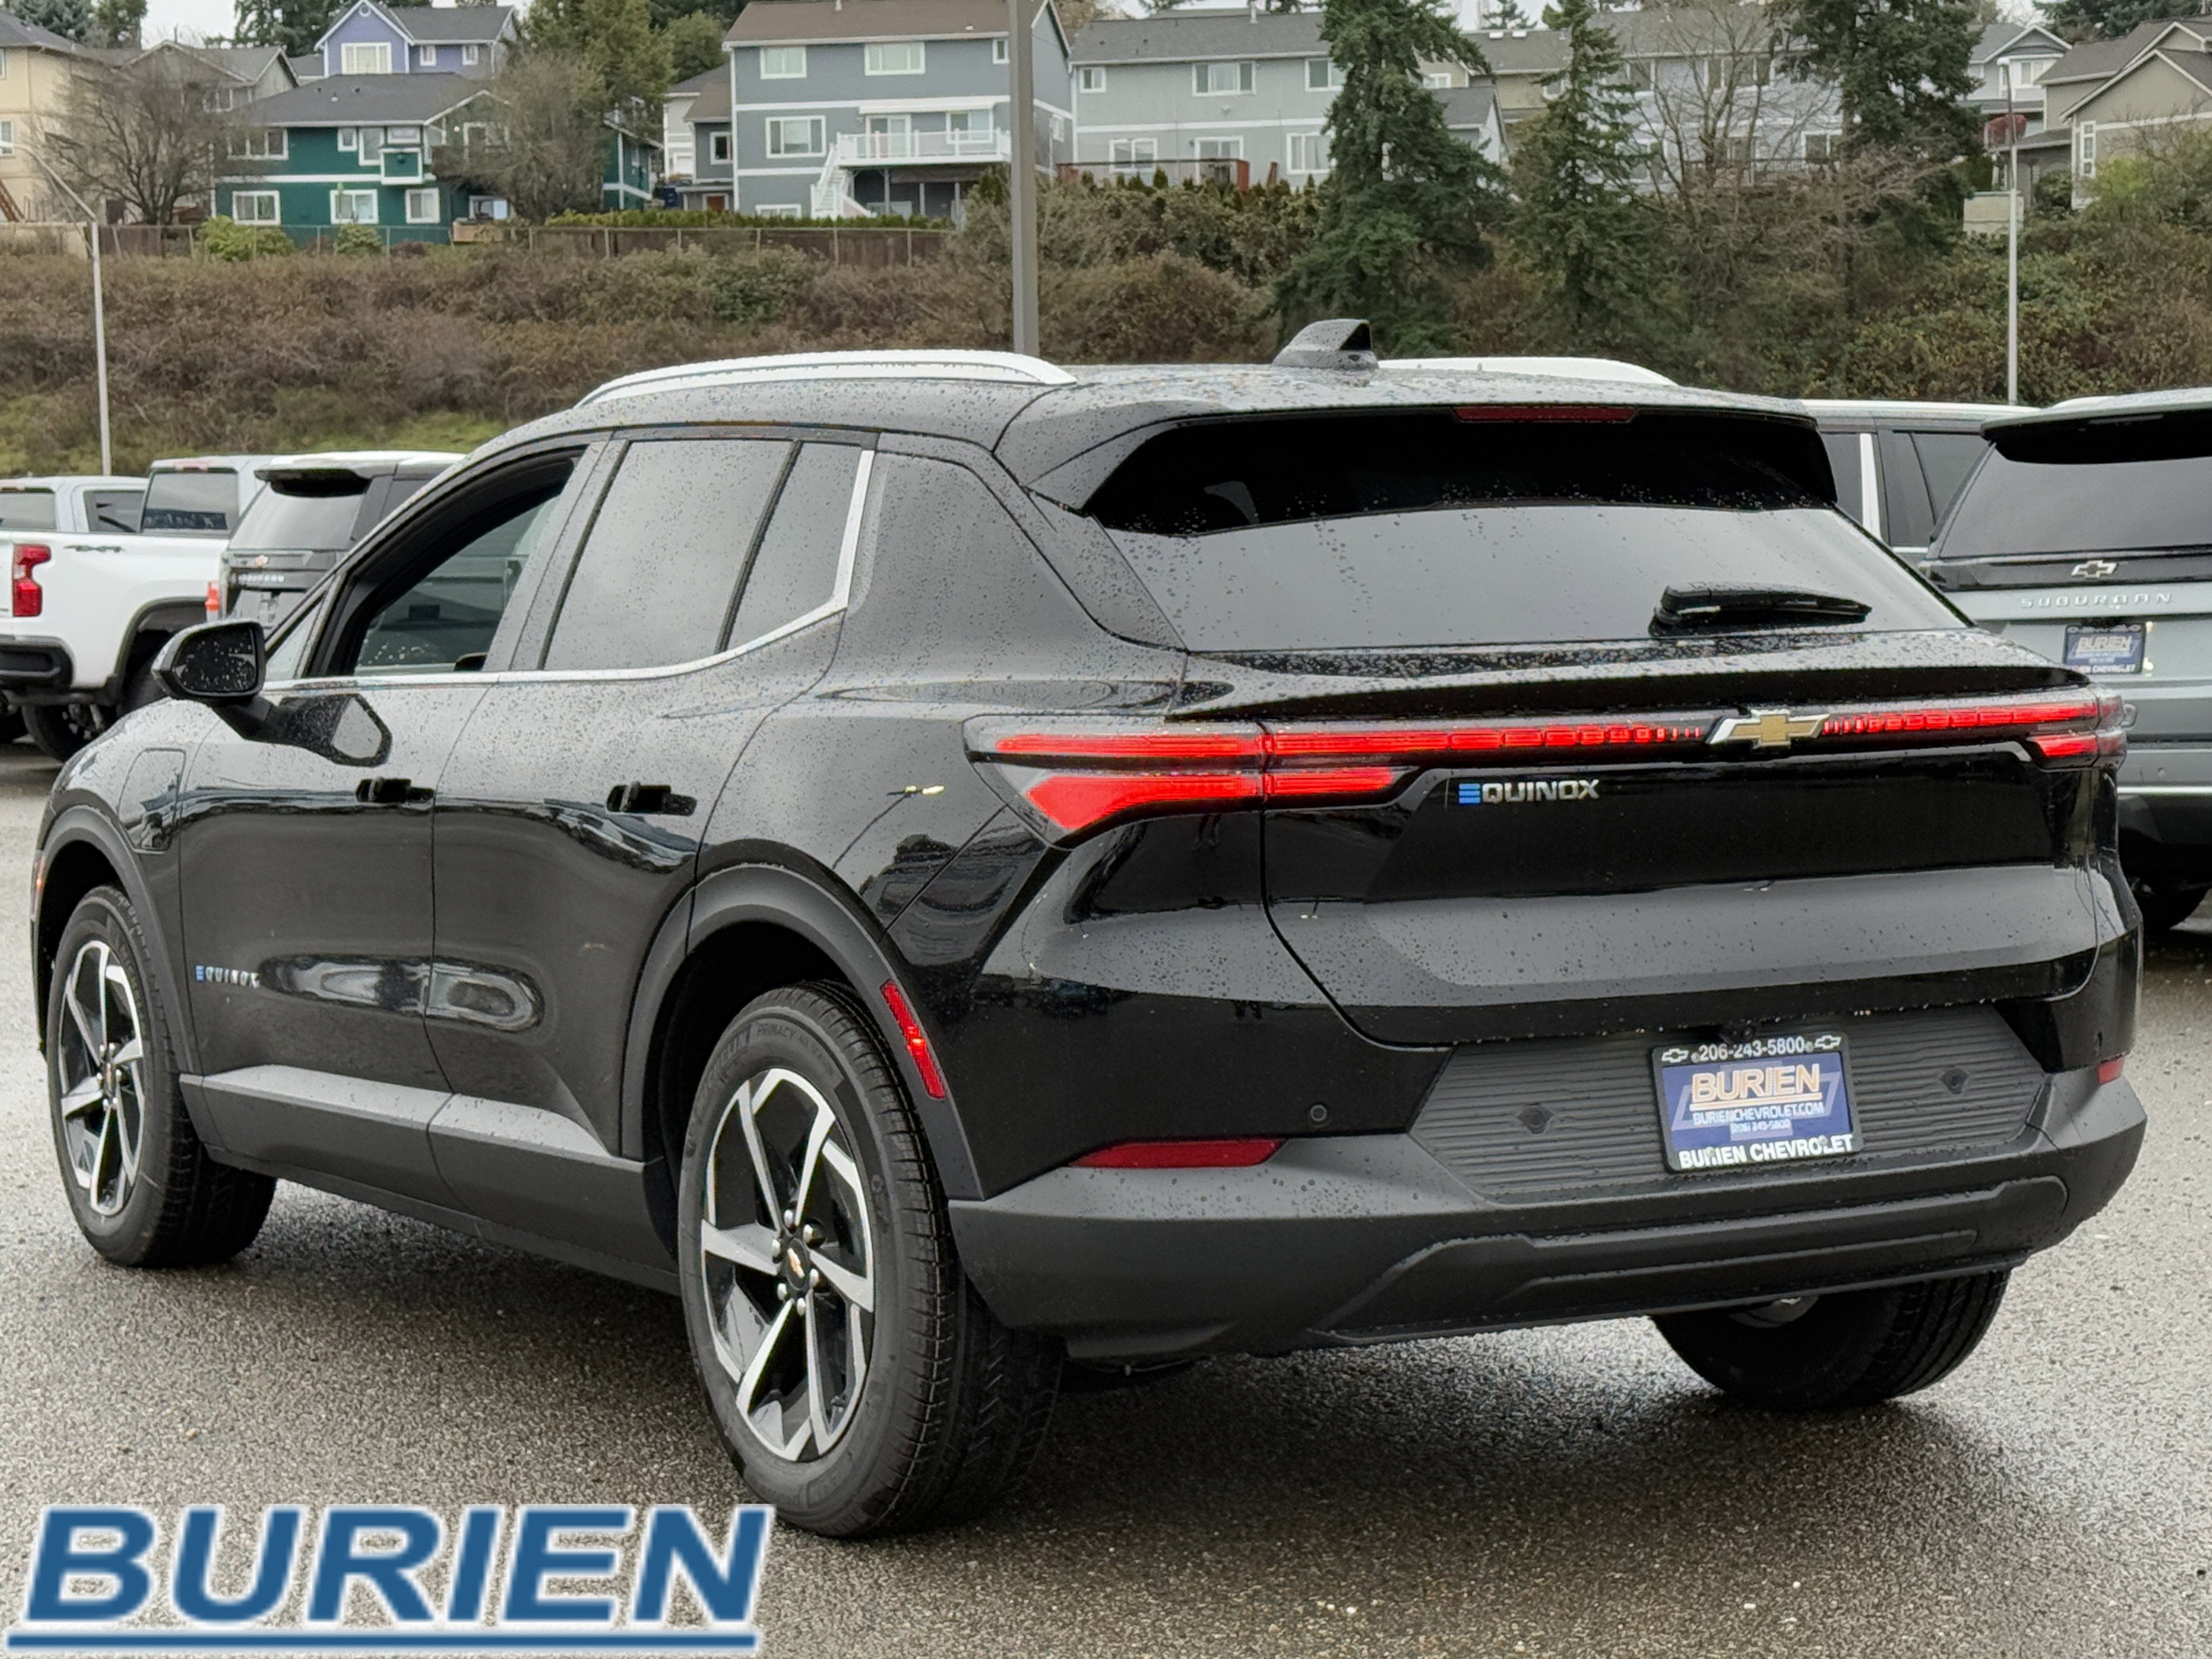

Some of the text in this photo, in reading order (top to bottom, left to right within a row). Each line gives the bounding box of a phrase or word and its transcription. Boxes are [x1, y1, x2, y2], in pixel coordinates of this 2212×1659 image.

[2021, 592, 2171, 608] SUBURBAN
[1459, 779, 1599, 803] EQUINOX
[196, 965, 260, 988] EQUINOX
[1699, 1036, 1805, 1061] 206-243-5800
[1692, 1063, 1820, 1103] BURIEN
